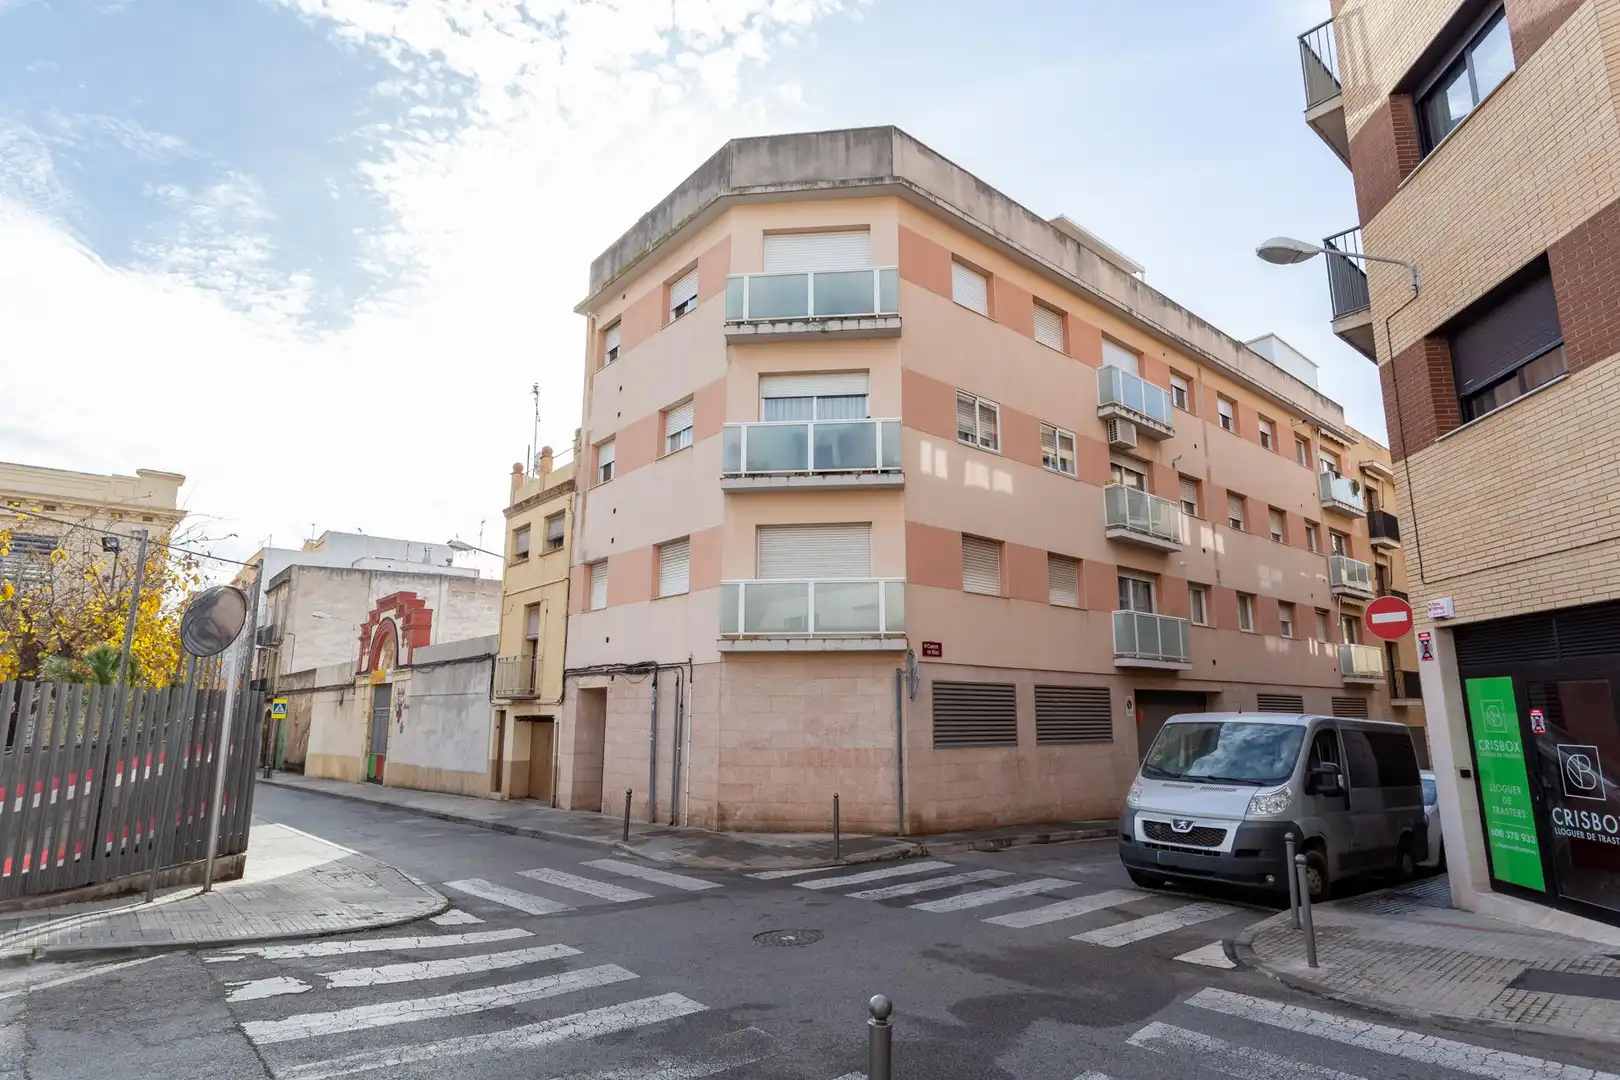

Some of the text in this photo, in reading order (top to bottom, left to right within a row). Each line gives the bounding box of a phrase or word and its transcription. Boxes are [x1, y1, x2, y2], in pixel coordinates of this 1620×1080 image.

[1478, 739, 1520, 752] CRISBOX
[1489, 784, 1521, 794] LLOGUER
[1502, 795, 1512, 805] DE
[1492, 806, 1527, 818] TRASTERS
[1552, 807, 1620, 834] CRISBO
[1554, 827, 1585, 839] LLOGUER
[1586, 832, 1596, 841] DE
